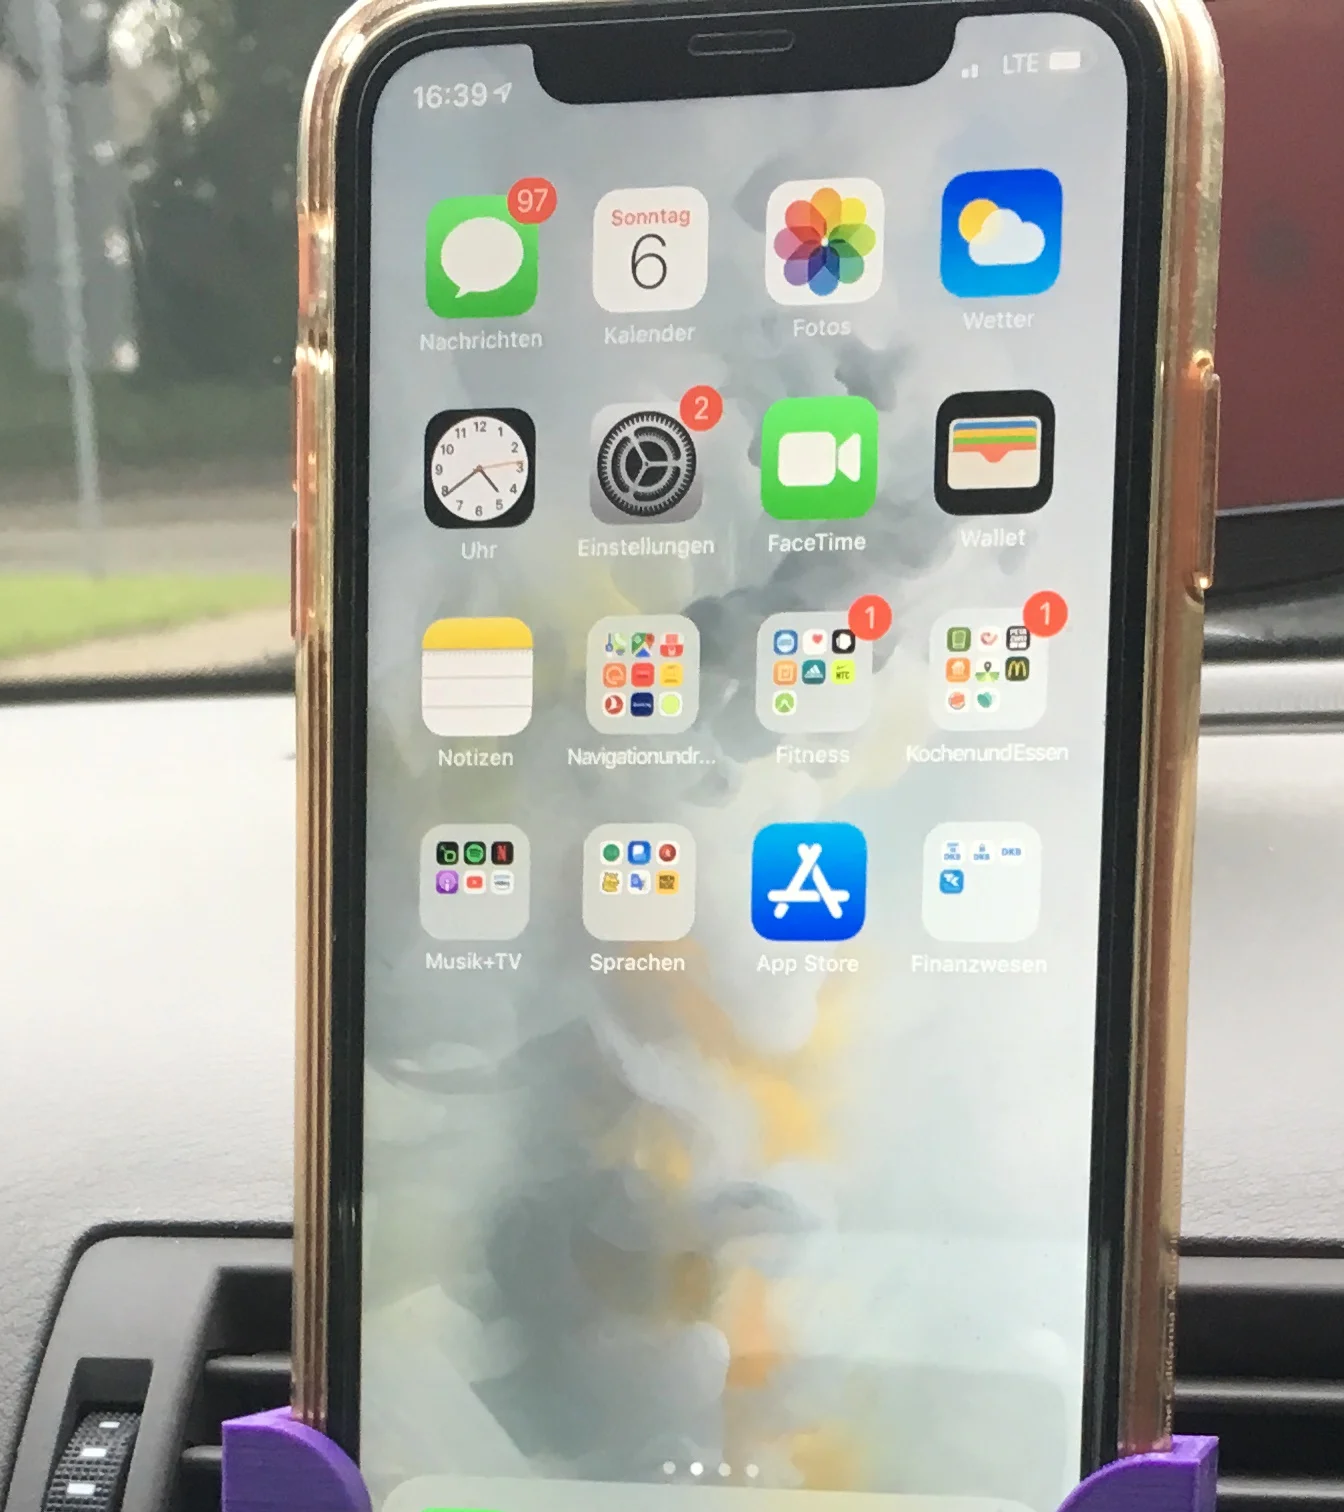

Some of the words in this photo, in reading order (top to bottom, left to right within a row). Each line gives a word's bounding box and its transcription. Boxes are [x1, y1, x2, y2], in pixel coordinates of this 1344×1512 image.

[1003, 52, 1038, 75] LTE
[413, 82, 488, 110] 16:39
[515, 187, 549, 214] 97
[610, 208, 692, 228] Sonntag
[630, 233, 668, 291] 6
[792, 317, 852, 338] Fotos
[962, 310, 1035, 331] Wetter
[419, 329, 544, 351] Nachrichten
[604, 324, 697, 345] Kalender
[693, 396, 710, 422] 2
[454, 427, 467, 440] 11
[473, 421, 488, 433] 12
[497, 426, 504, 437] 1
[440, 444, 454, 456] 10
[510, 442, 519, 454] 2
[434, 463, 443, 476] 9
[509, 483, 518, 495] 4
[455, 500, 464, 512] 7
[474, 505, 484, 517] 6
[496, 499, 504, 511] 5
[768, 532, 867, 553] FaceTime
[960, 527, 1026, 548] Wallet
[461, 541, 498, 560] Uhr
[577, 537, 715, 559] Einstellungen
[863, 605, 875, 630] 1
[1039, 601, 1051, 626] 1
[438, 748, 514, 768] Notizen
[775, 745, 851, 764] Fitness
[906, 743, 1070, 763] KochenundEssen
[425, 952, 522, 971] Musik+TV
[590, 952, 685, 975] Sprachen
[756, 954, 798, 976] App
[804, 953, 860, 973] Store
[911, 954, 1048, 974] Finanzwesen
